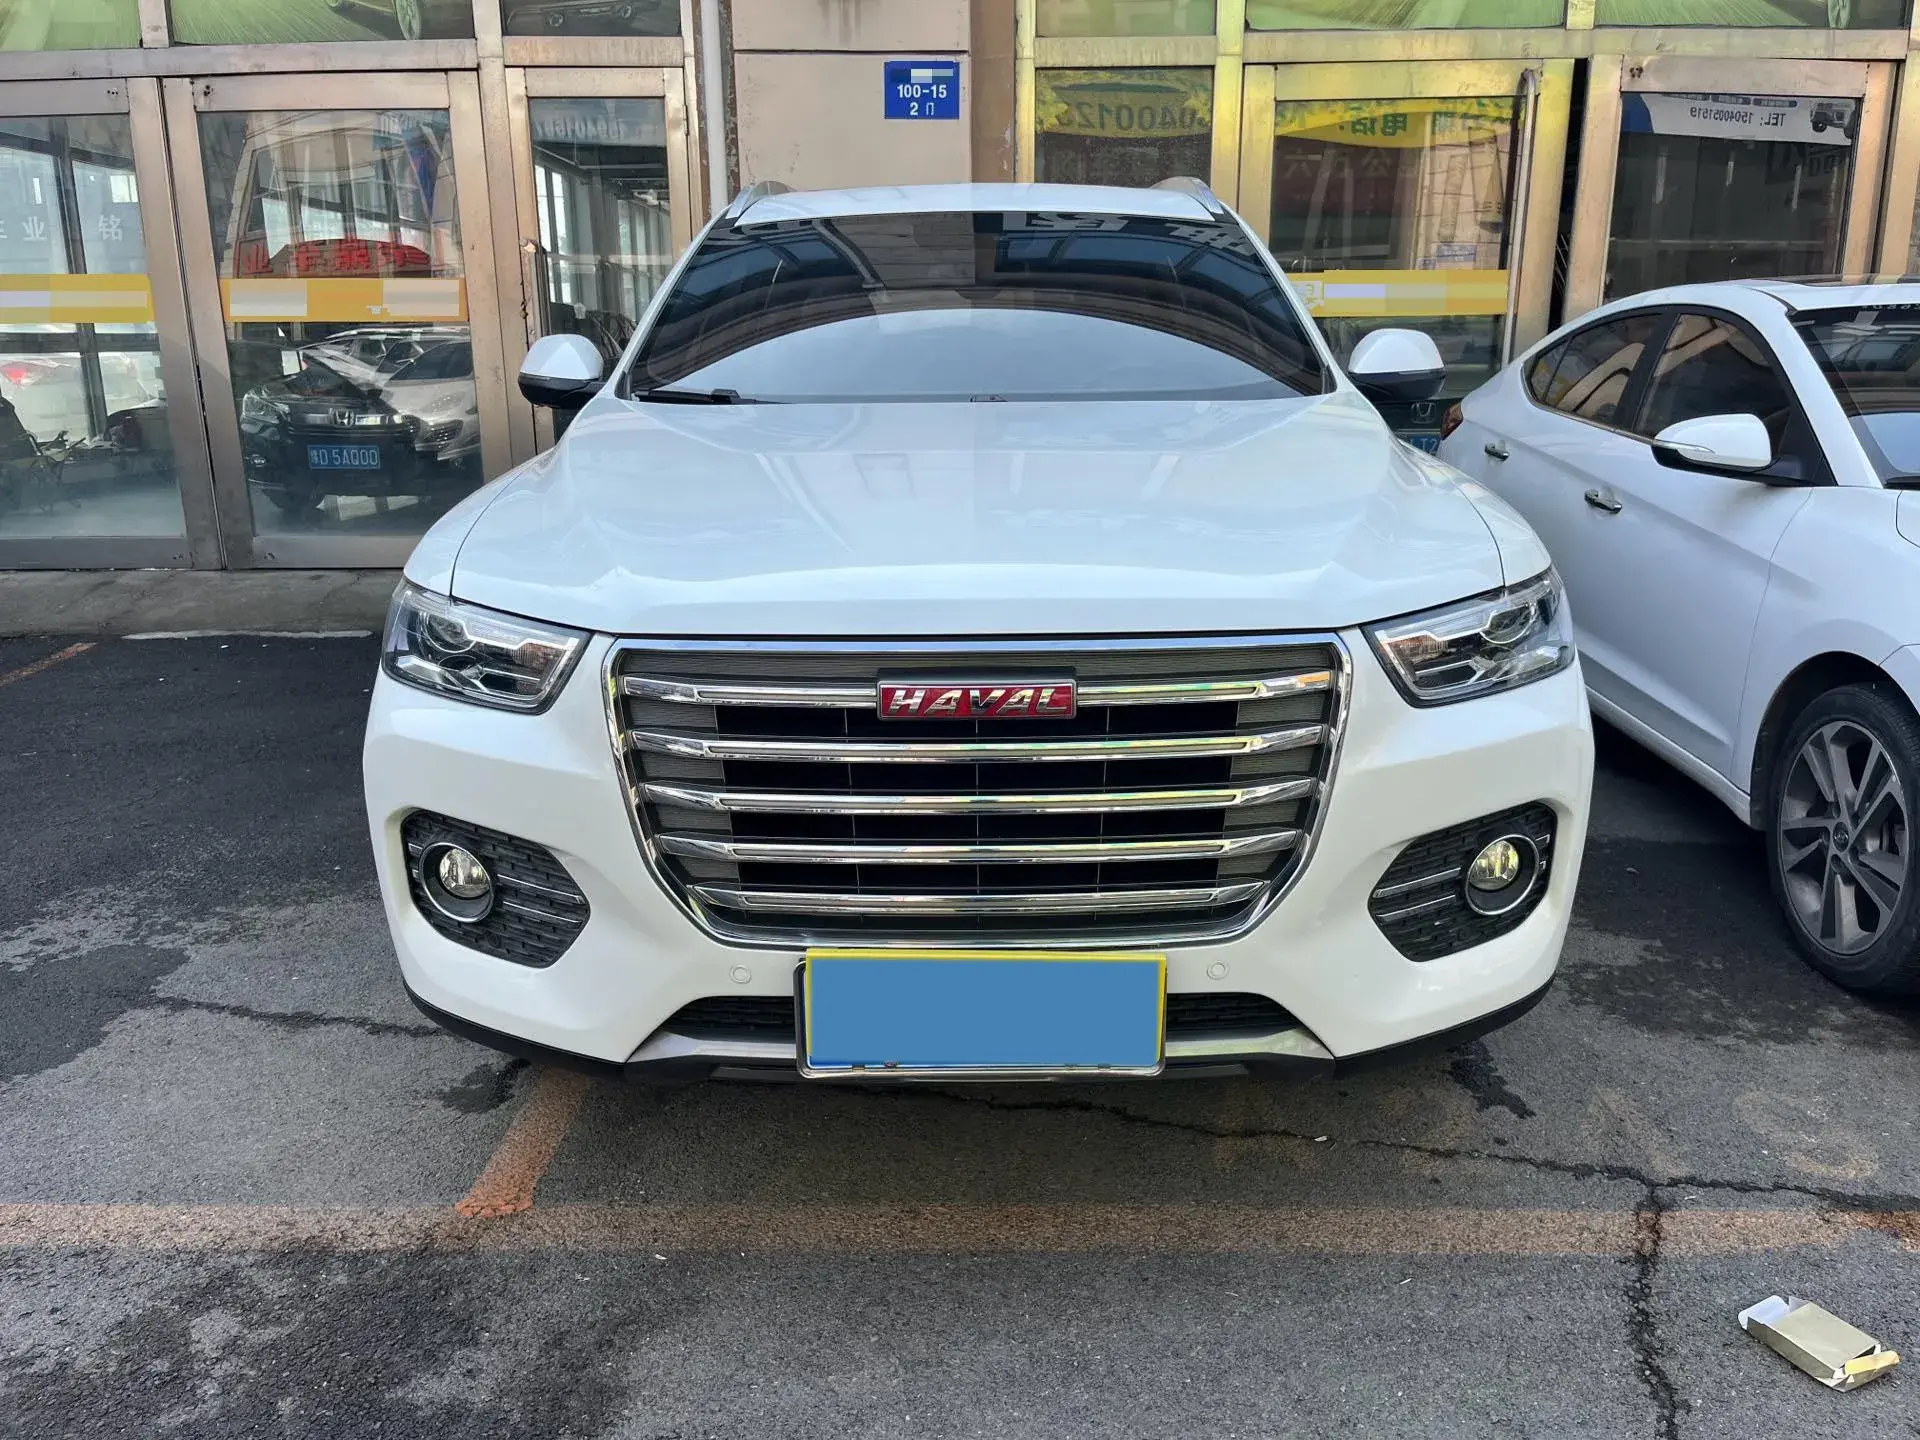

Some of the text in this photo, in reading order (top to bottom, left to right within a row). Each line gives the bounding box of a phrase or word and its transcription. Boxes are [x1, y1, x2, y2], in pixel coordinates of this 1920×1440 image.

[897, 84, 947, 98] 100-15
[909, 102, 919, 115] 2
[887, 688, 1067, 714] HAVAL
